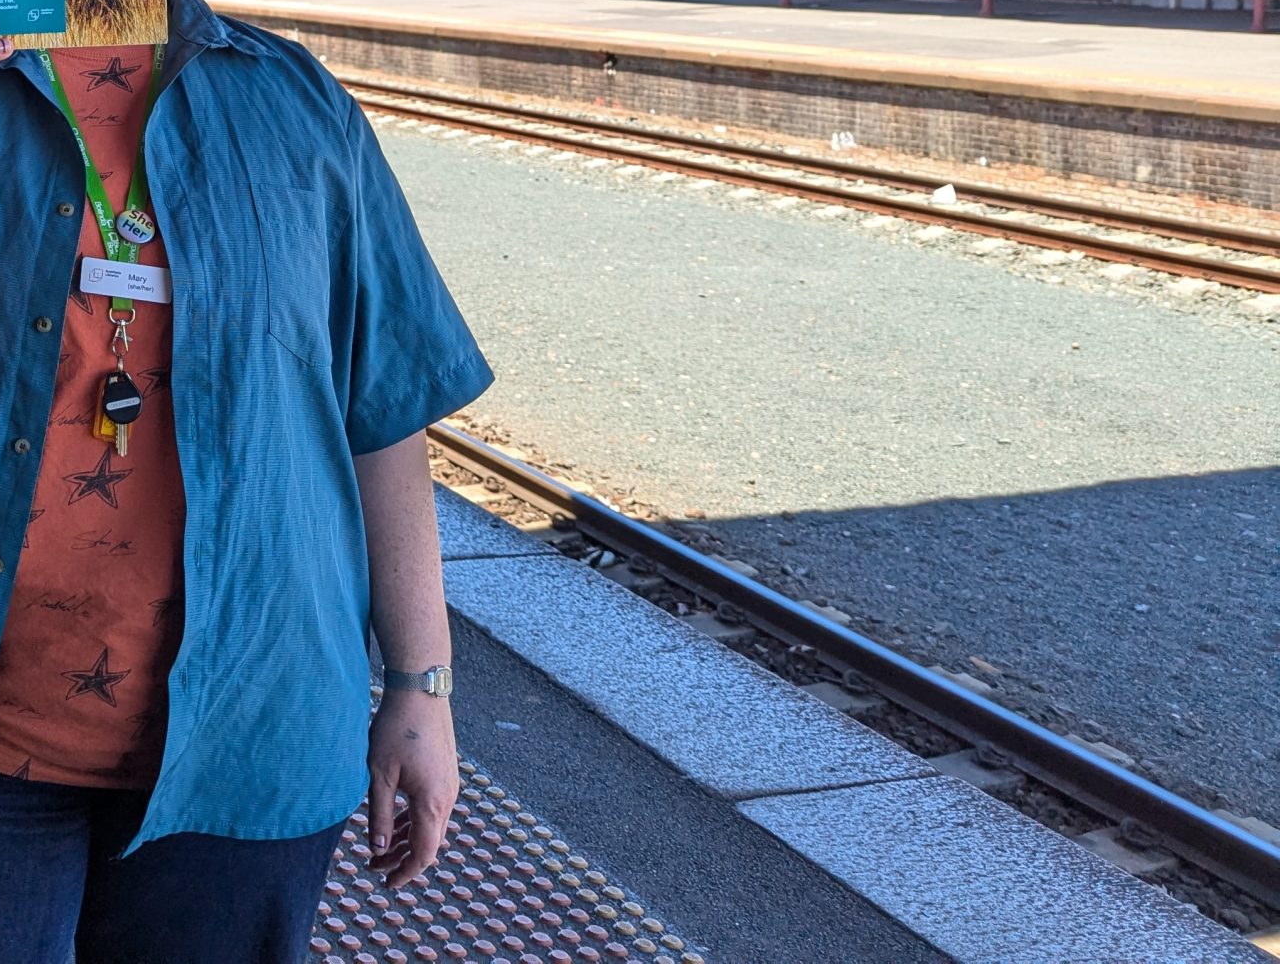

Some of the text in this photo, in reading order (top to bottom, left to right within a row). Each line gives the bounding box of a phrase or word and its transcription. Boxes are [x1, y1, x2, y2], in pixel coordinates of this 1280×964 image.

[122, 219, 148, 239] Her
[128, 209, 154, 230] She
[128, 274, 147, 284] Mary
